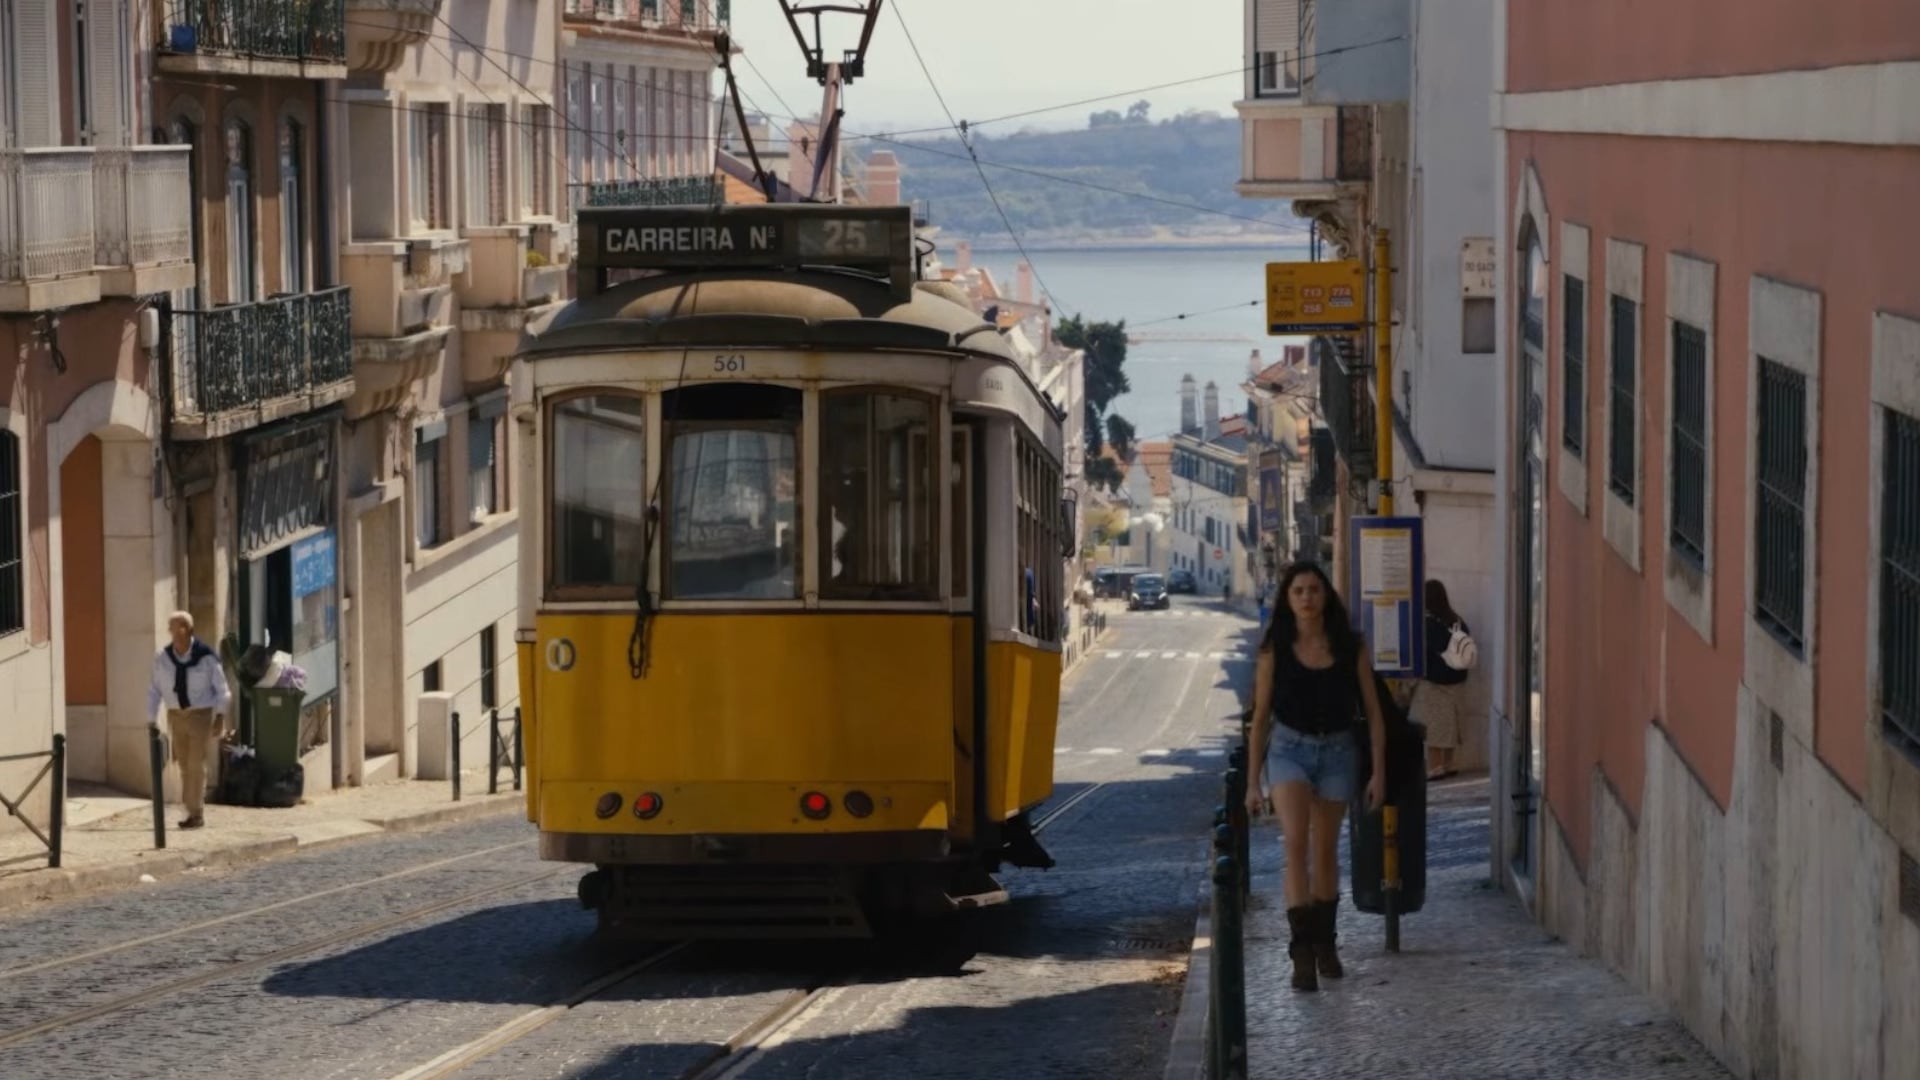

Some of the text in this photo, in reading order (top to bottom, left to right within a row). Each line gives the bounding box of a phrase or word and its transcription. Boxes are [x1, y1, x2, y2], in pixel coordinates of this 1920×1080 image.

[606, 227, 735, 251] CARREIRA
[823, 220, 867, 249] 25
[714, 354, 745, 372] 561
